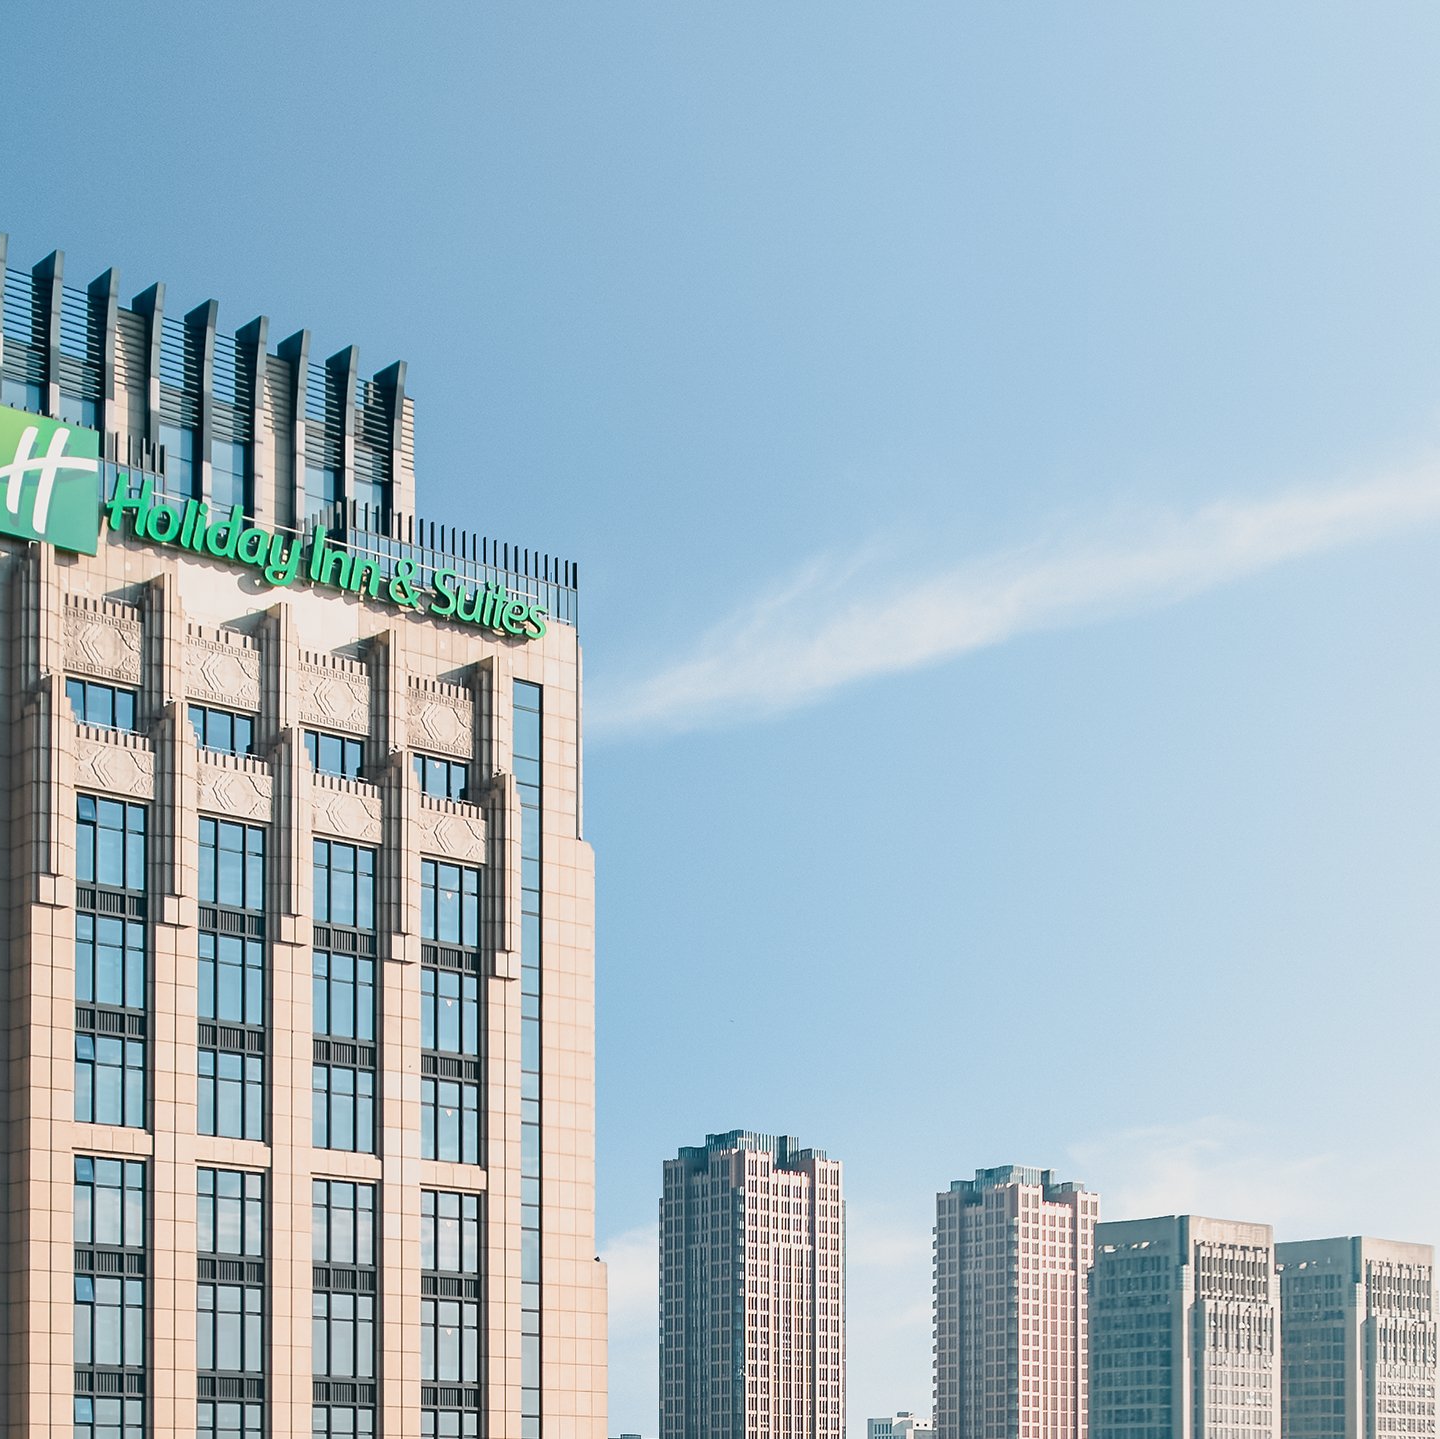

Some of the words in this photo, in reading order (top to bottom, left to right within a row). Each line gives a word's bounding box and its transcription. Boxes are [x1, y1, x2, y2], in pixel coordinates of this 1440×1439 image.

[107, 472, 301, 587] Holiday
[310, 525, 381, 597] Inn
[388, 558, 421, 608] &
[431, 568, 549, 640] Suites
